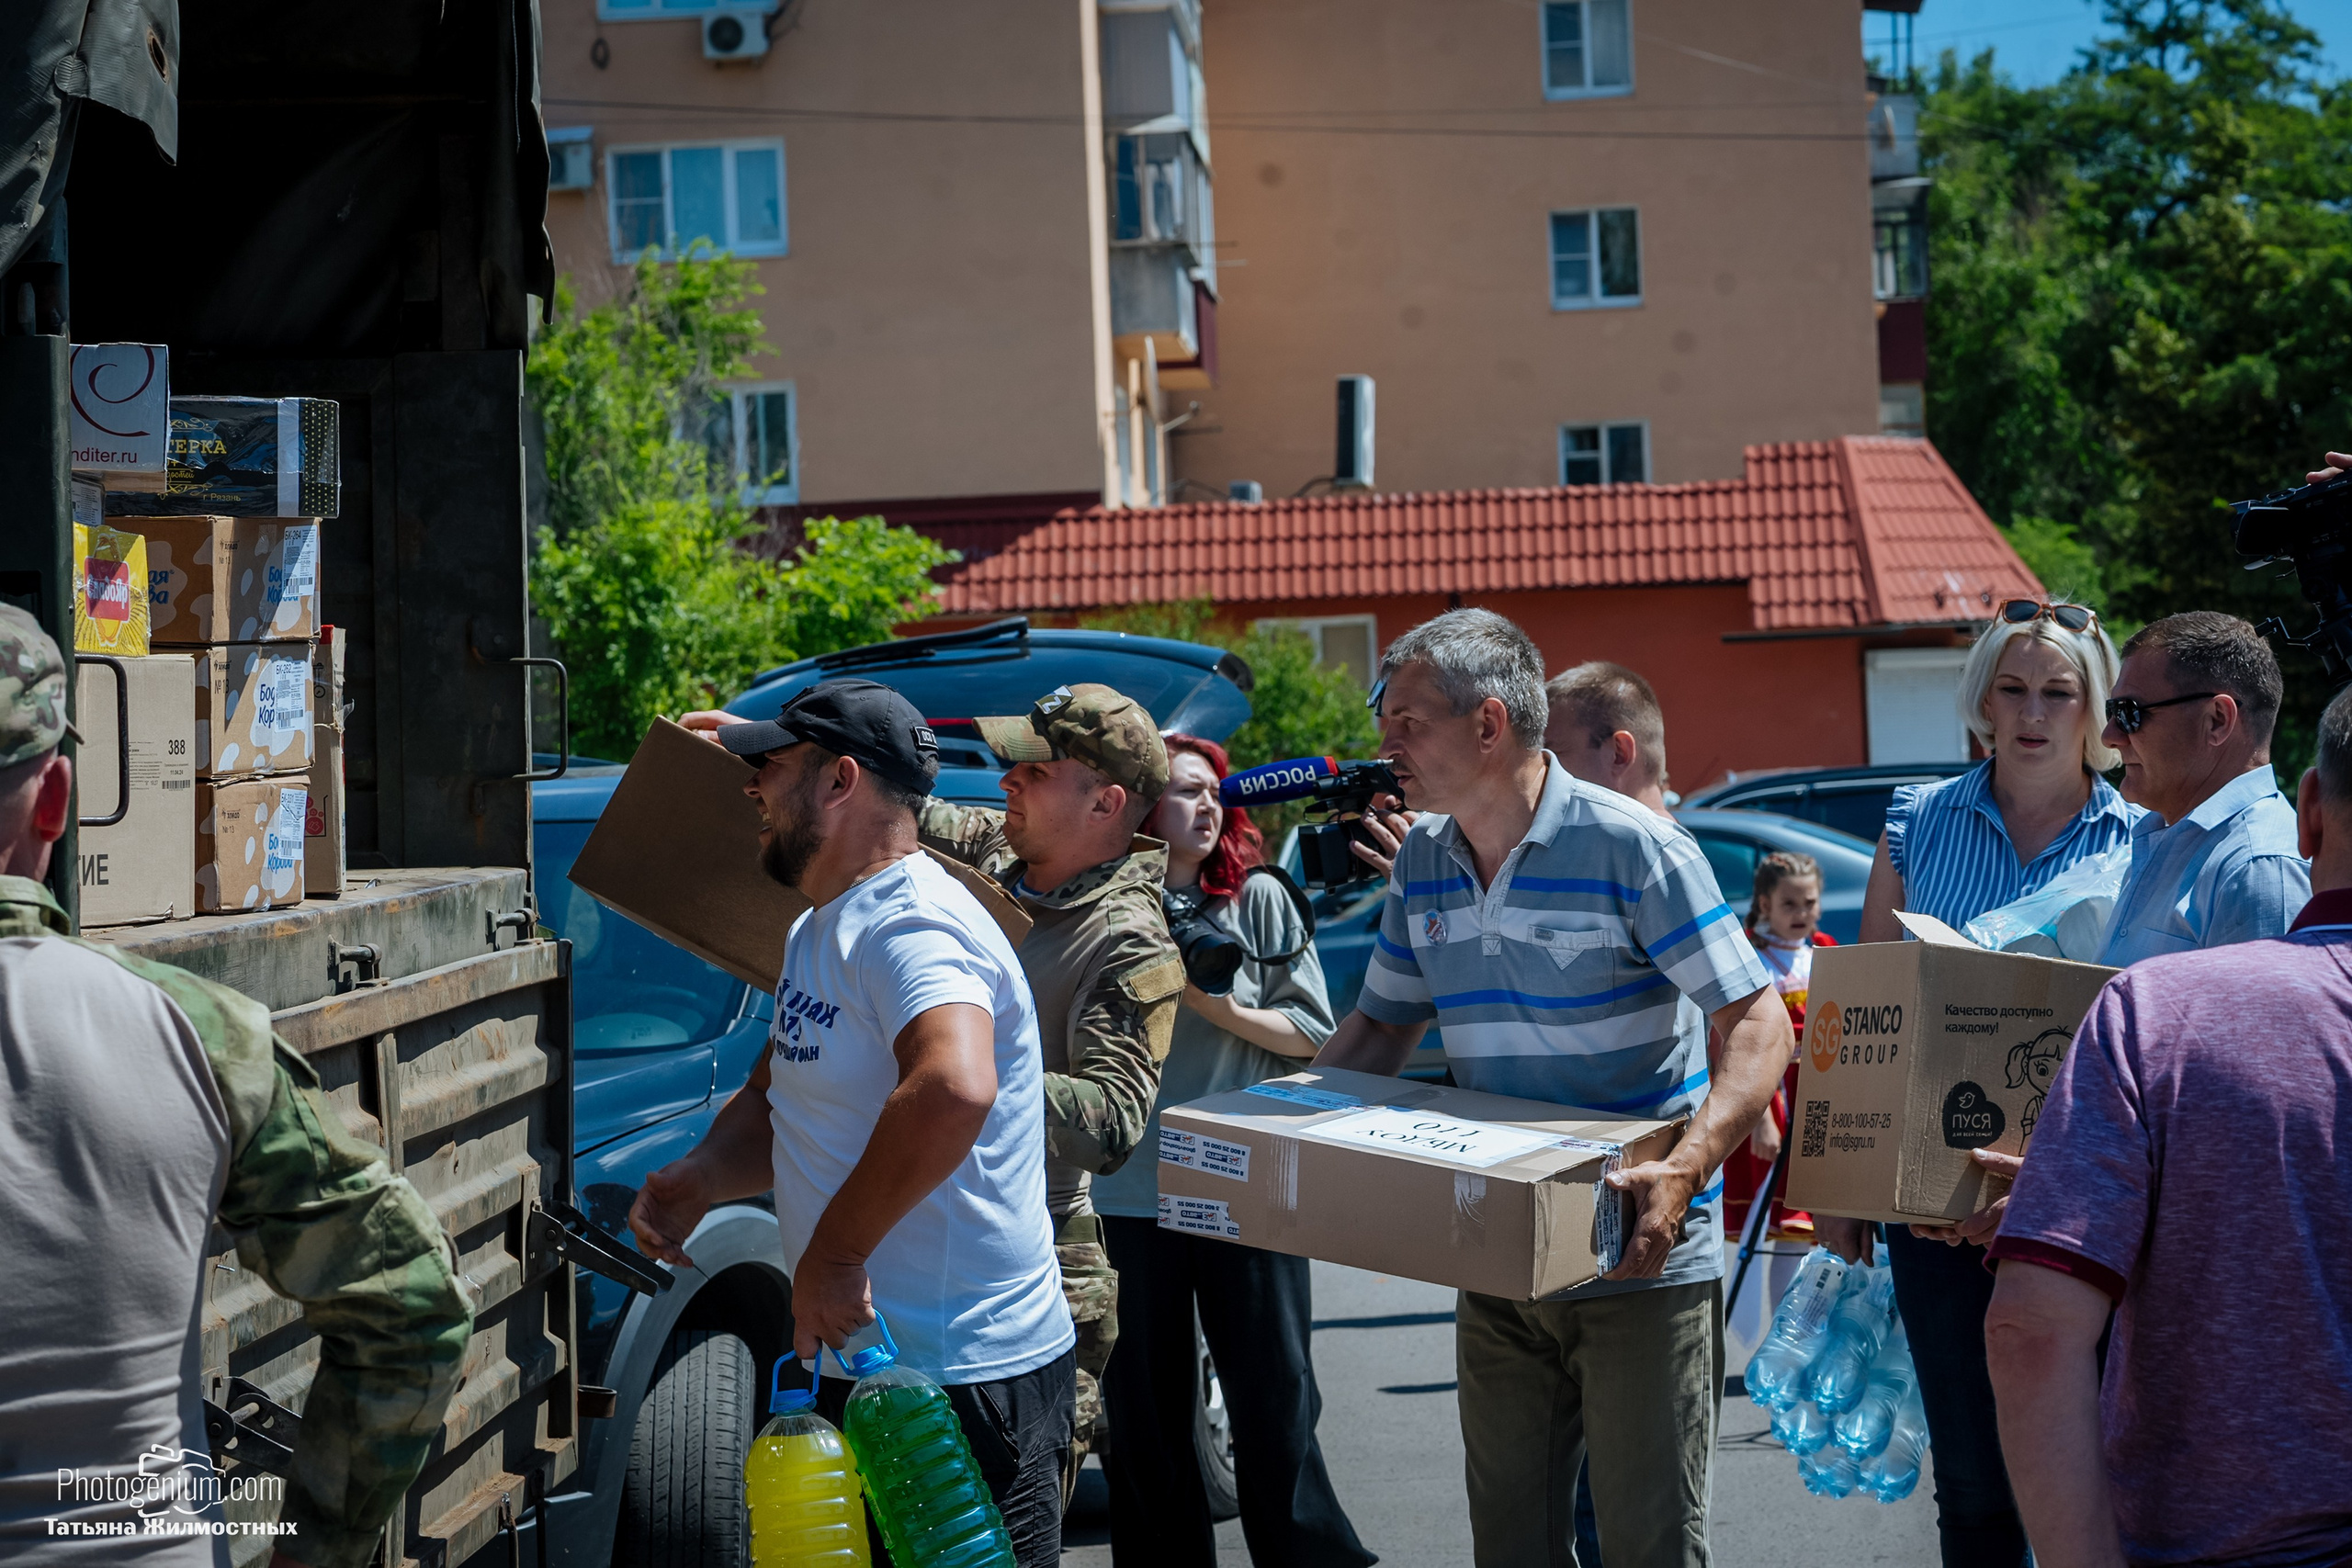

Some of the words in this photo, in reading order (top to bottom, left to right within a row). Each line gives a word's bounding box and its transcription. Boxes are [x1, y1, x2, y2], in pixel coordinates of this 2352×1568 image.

[210, 492, 241, 502] Рязань
[168, 739, 186, 755] 388
[1239, 765, 1317, 795] РОССИЯ
[79, 853, 109, 886] ИЕ
[1843, 1004, 1903, 1036] STANCO
[1945, 1004, 1998, 1016] Качество
[1999, 1008, 2053, 1019] доступно
[1813, 1018, 1840, 1056] SG
[1945, 1021, 1999, 1035] каждому!
[1840, 1043, 1898, 1065] GROUP
[1832, 1113, 1892, 1128] 8-800-100-57-25
[1952, 1113, 1991, 1129] ПУСЯ
[1354, 1130, 1477, 1153] МБДОУ
[1829, 1133, 1875, 1152] info@sgru.ru
